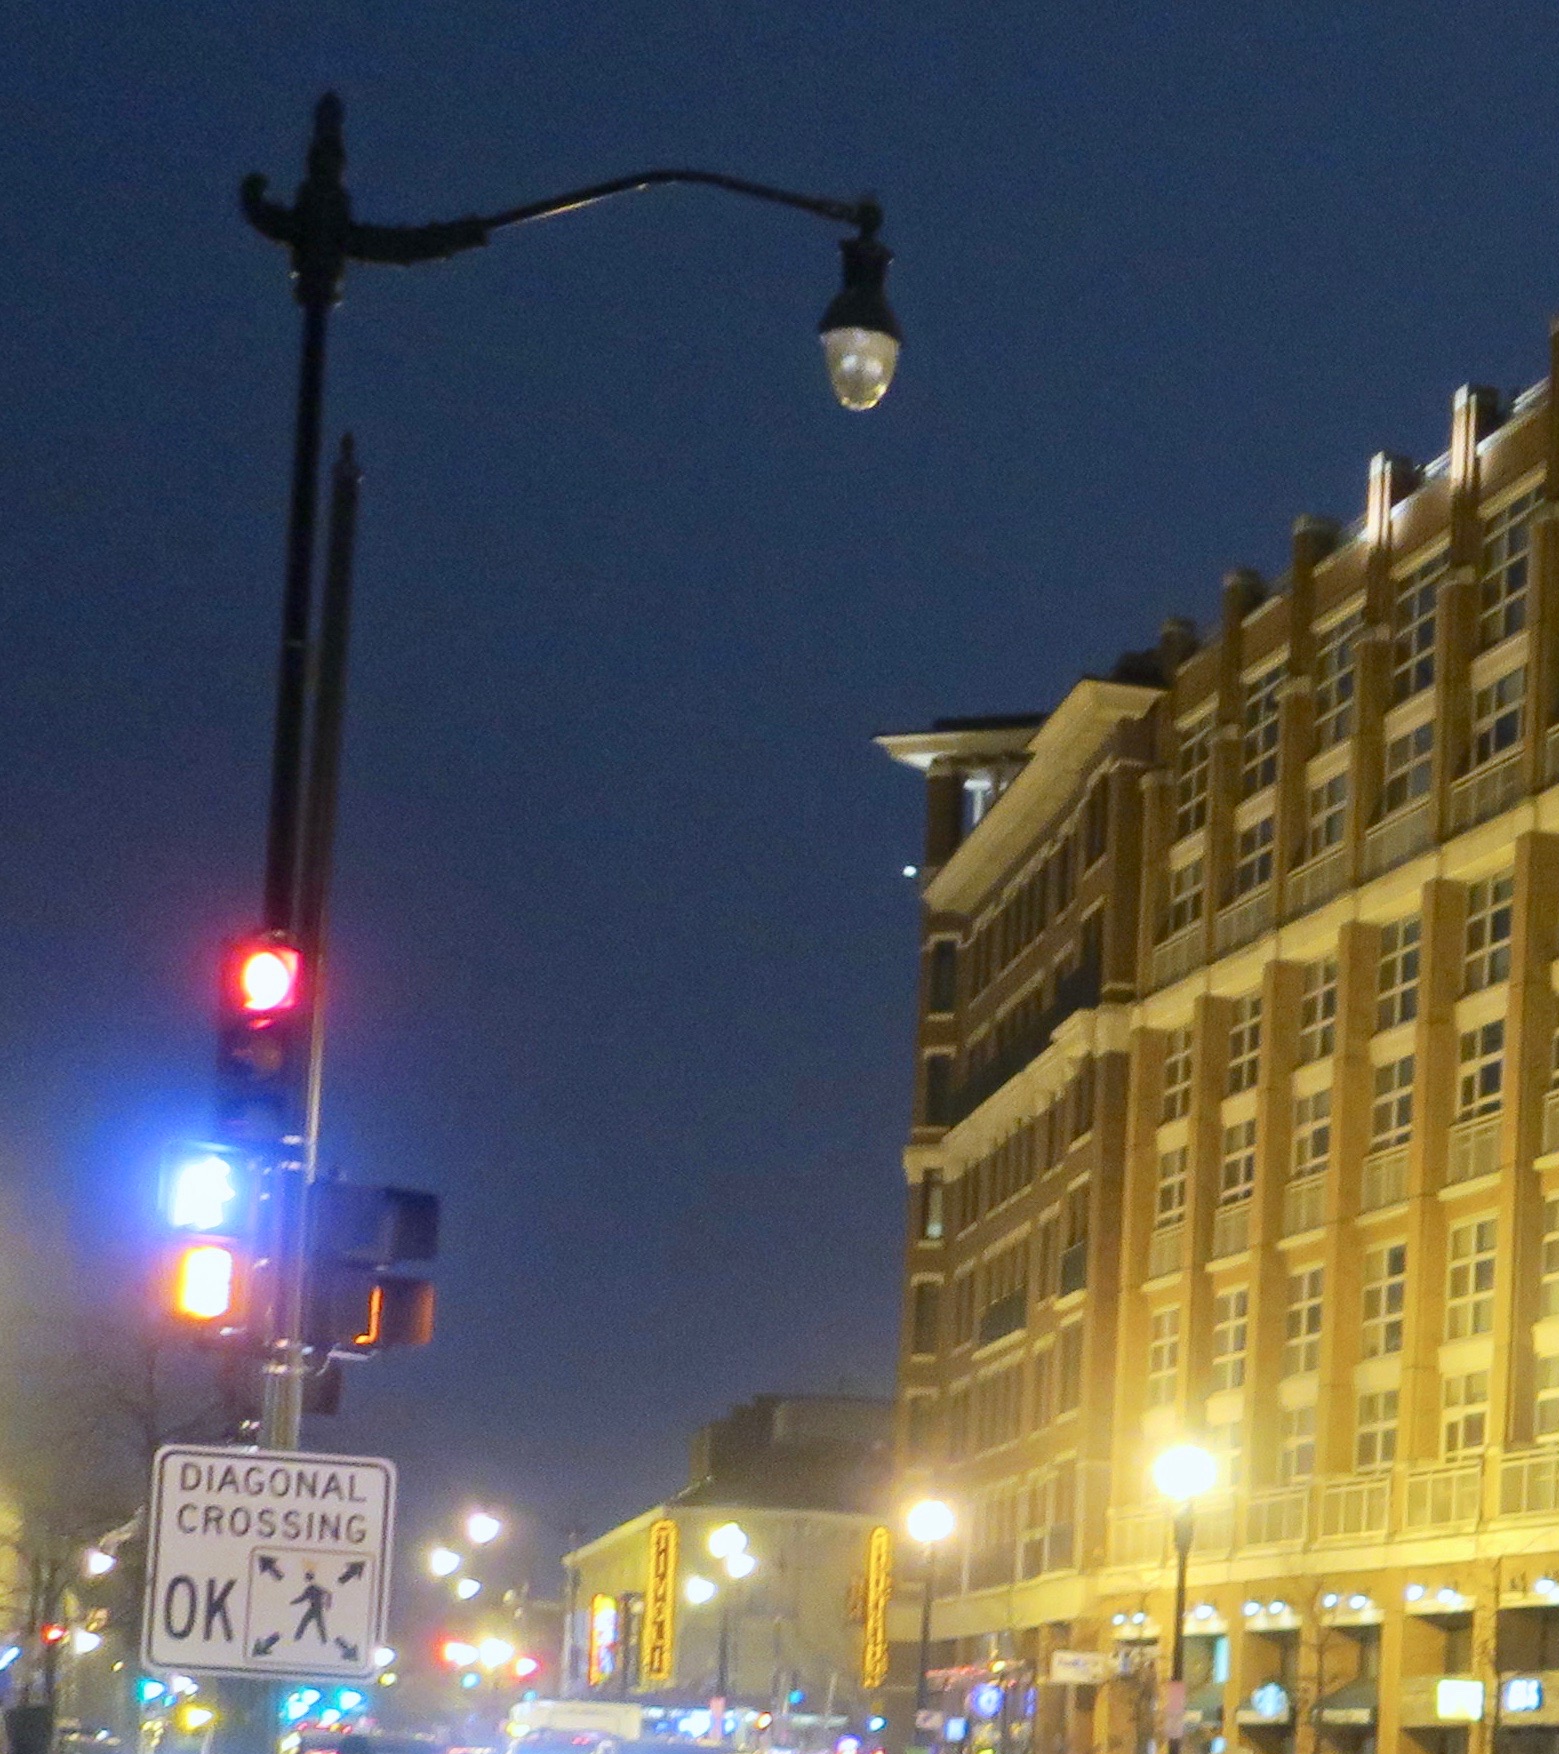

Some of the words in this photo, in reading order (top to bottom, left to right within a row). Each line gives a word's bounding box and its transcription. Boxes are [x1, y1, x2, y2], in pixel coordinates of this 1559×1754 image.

[179, 1461, 367, 1503] DIAGONAL
[176, 1502, 368, 1545] CROSSING
[164, 1574, 238, 1643] OK
